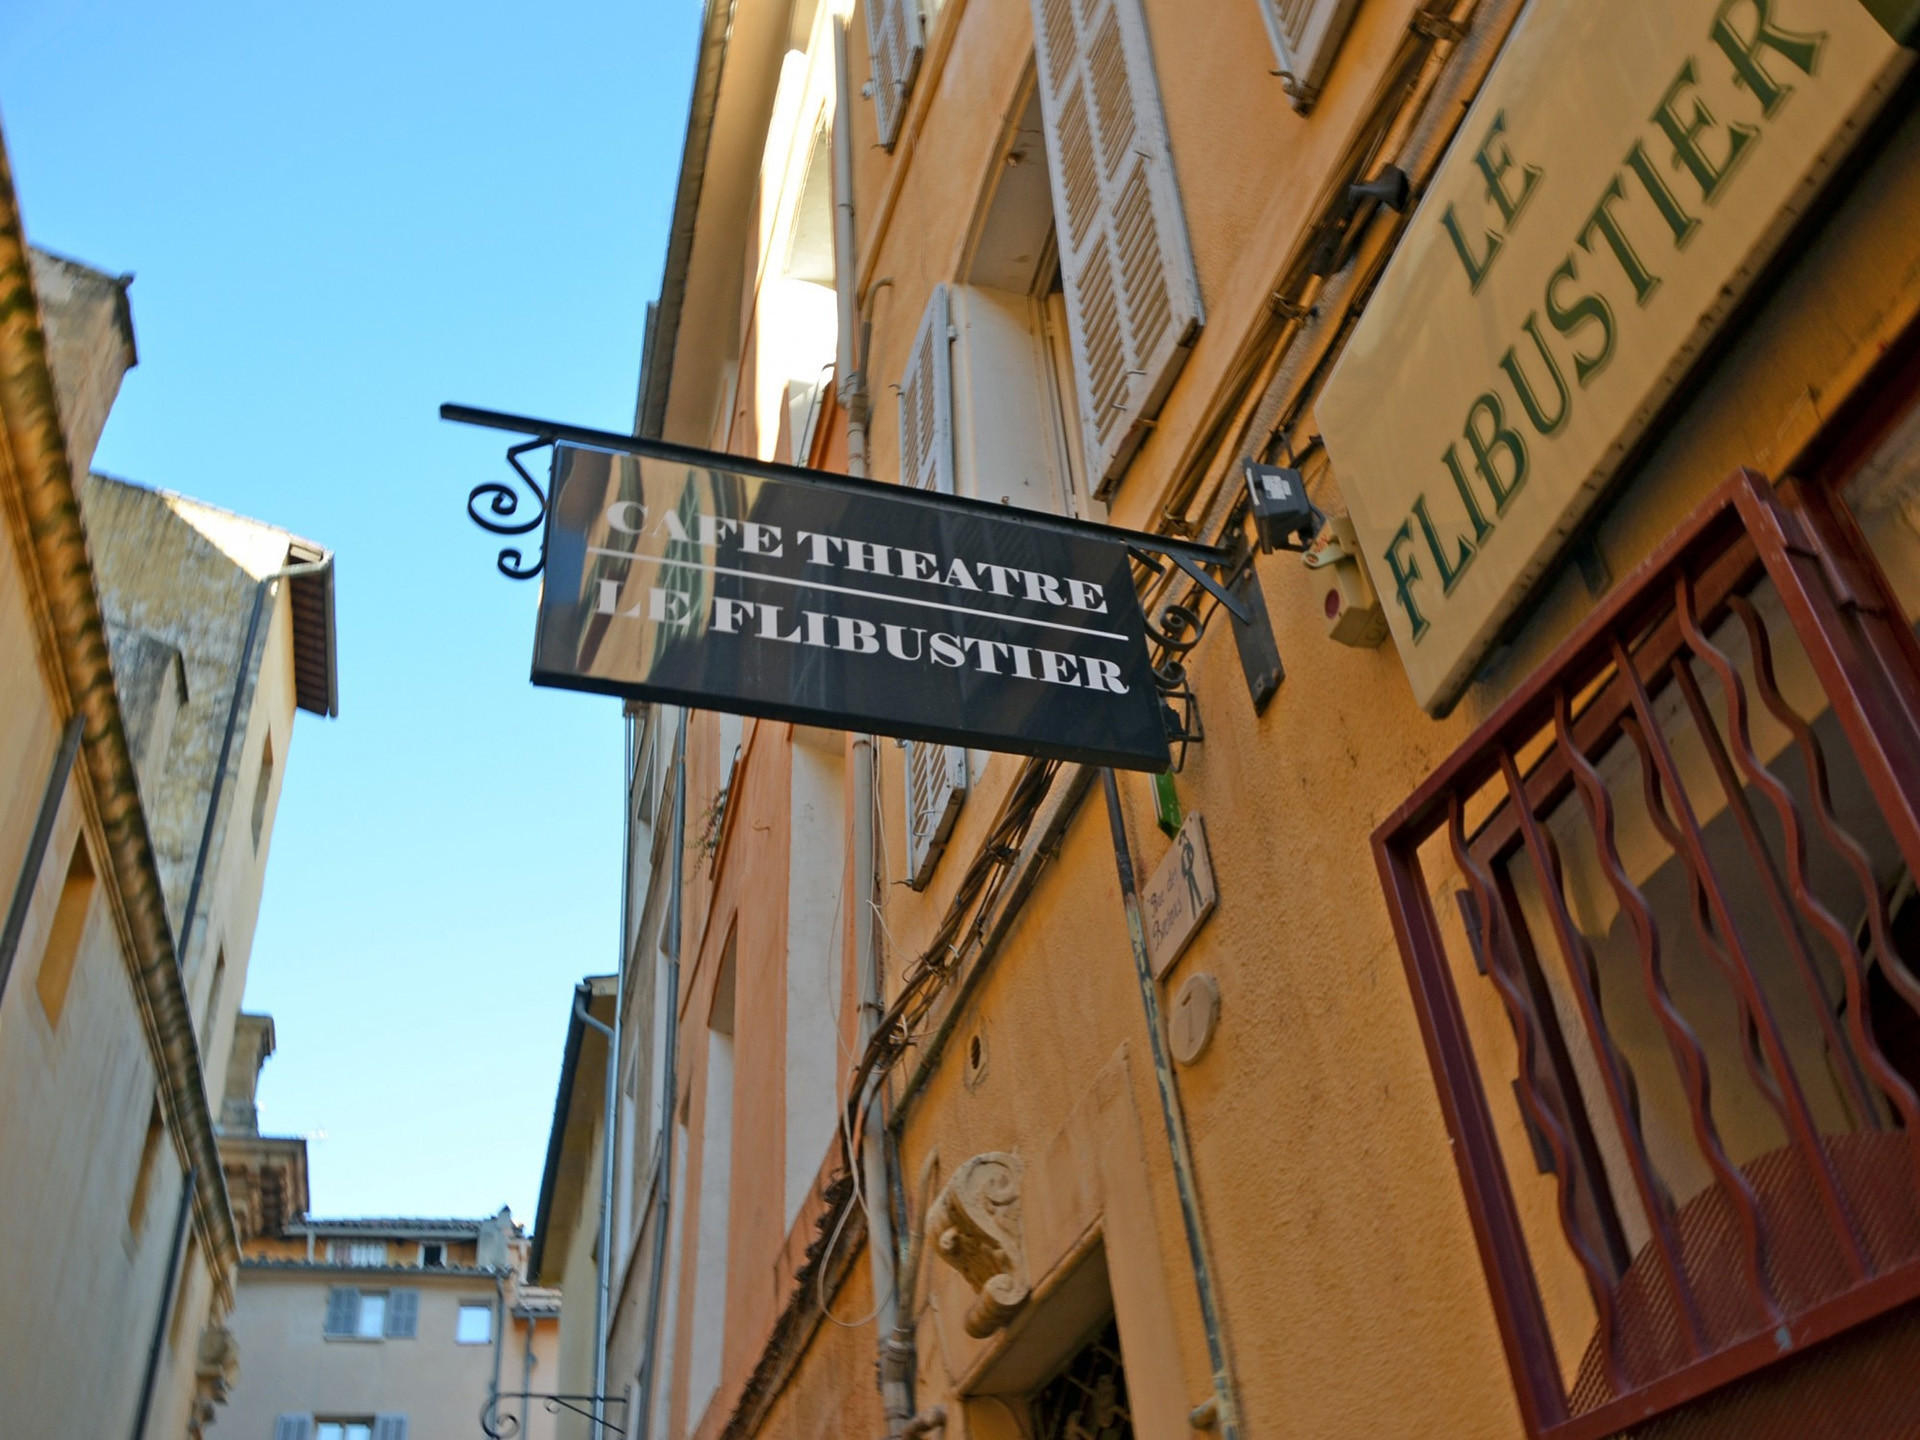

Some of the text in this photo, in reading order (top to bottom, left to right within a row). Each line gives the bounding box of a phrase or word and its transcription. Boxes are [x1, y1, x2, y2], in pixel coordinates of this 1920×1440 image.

[1438, 107, 1544, 297] LE
[1383, 0, 1830, 648] FLIBUSTIER
[605, 500, 1109, 614] CAFE THEATRE
[593, 578, 1130, 695] LE FLIBUSTIER
